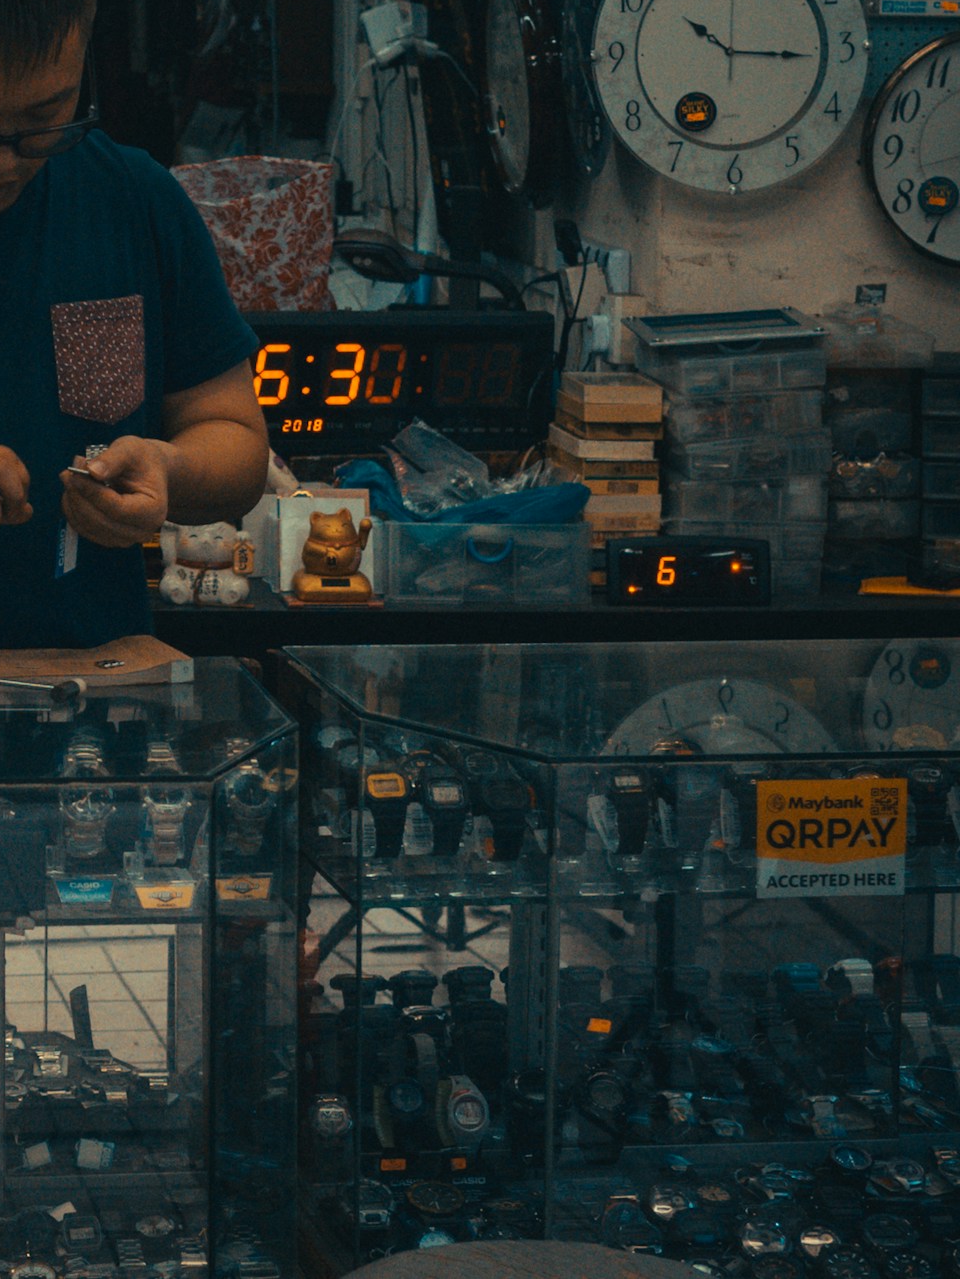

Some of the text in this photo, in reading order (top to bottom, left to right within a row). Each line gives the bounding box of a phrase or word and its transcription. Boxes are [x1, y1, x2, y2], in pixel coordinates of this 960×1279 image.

[608, 41, 625, 73] 9
[838, 31, 855, 63] 3
[926, 57, 951, 88] 11
[625, 99, 641, 131] 8
[823, 91, 841, 122] 4
[891, 89, 921, 123] 10
[667, 141, 684, 172] 7
[785, 136, 800, 167] 5
[883, 134, 903, 169] 9
[726, 153, 743, 185] 6
[892, 178, 914, 214] 8
[656, 555, 677, 586] 6
[788, 795, 864, 811] Maybank
[766, 818, 897, 849] QRPAY
[766, 873, 897, 889] ACCEPTED HERE
[452, 1176, 487, 1185] CASIO
